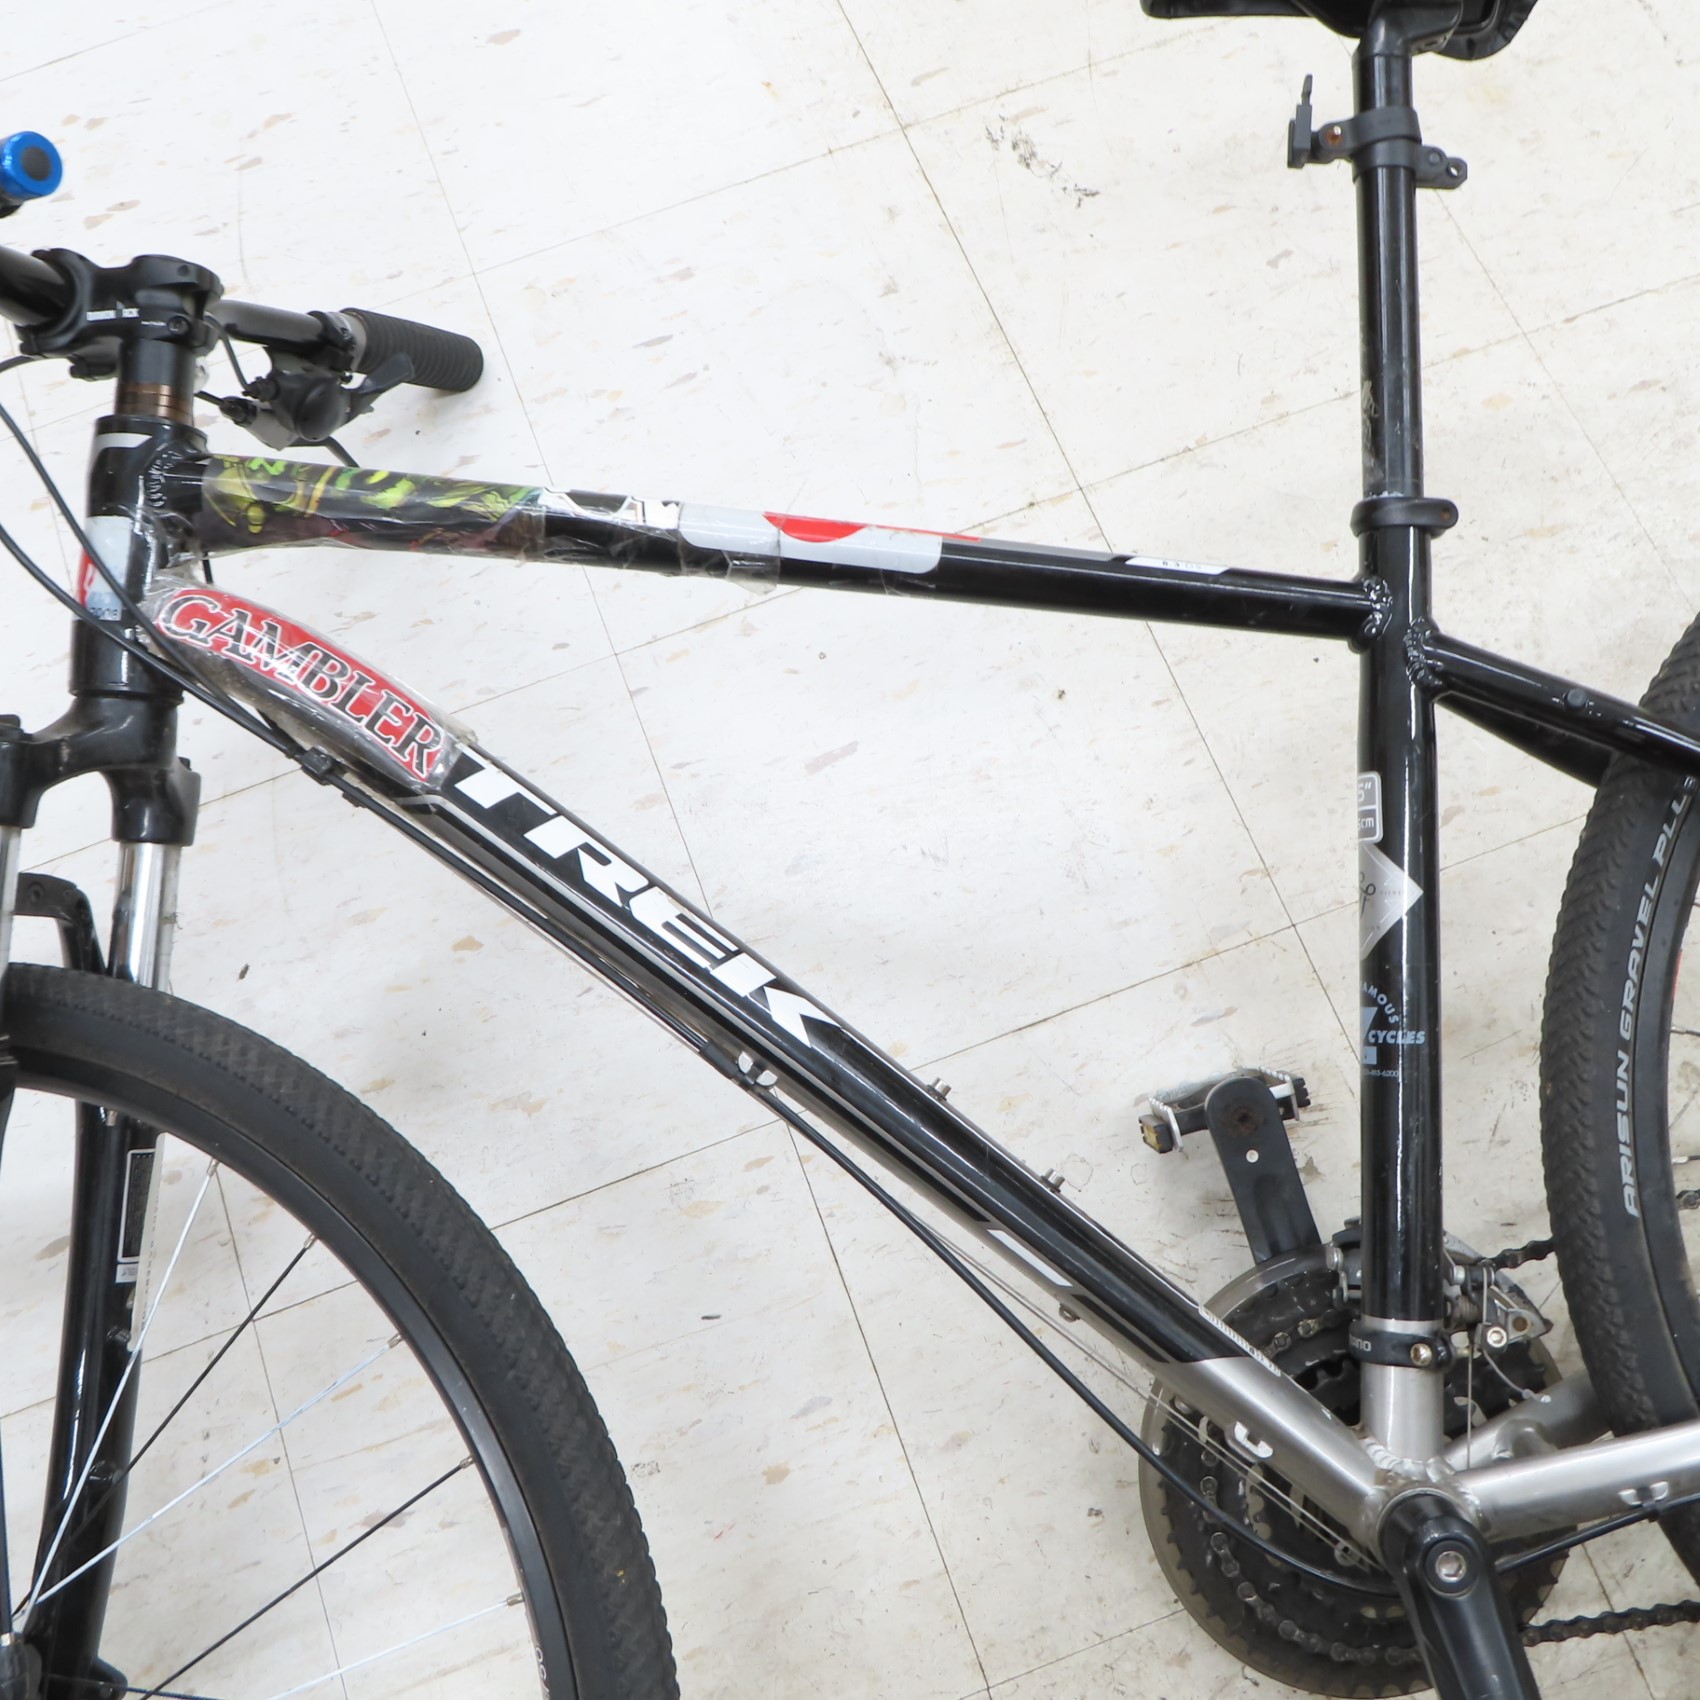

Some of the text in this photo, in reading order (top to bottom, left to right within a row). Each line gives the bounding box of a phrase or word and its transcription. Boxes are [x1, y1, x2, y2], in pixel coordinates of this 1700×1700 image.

[156, 594, 444, 781] GAMBLER
[453, 743, 842, 1048] TREK
[1620, 875, 1659, 1041] GRAVEL
[1368, 1029, 1426, 1045] CYCLES
[1616, 1049, 1640, 1218] ARISUN
